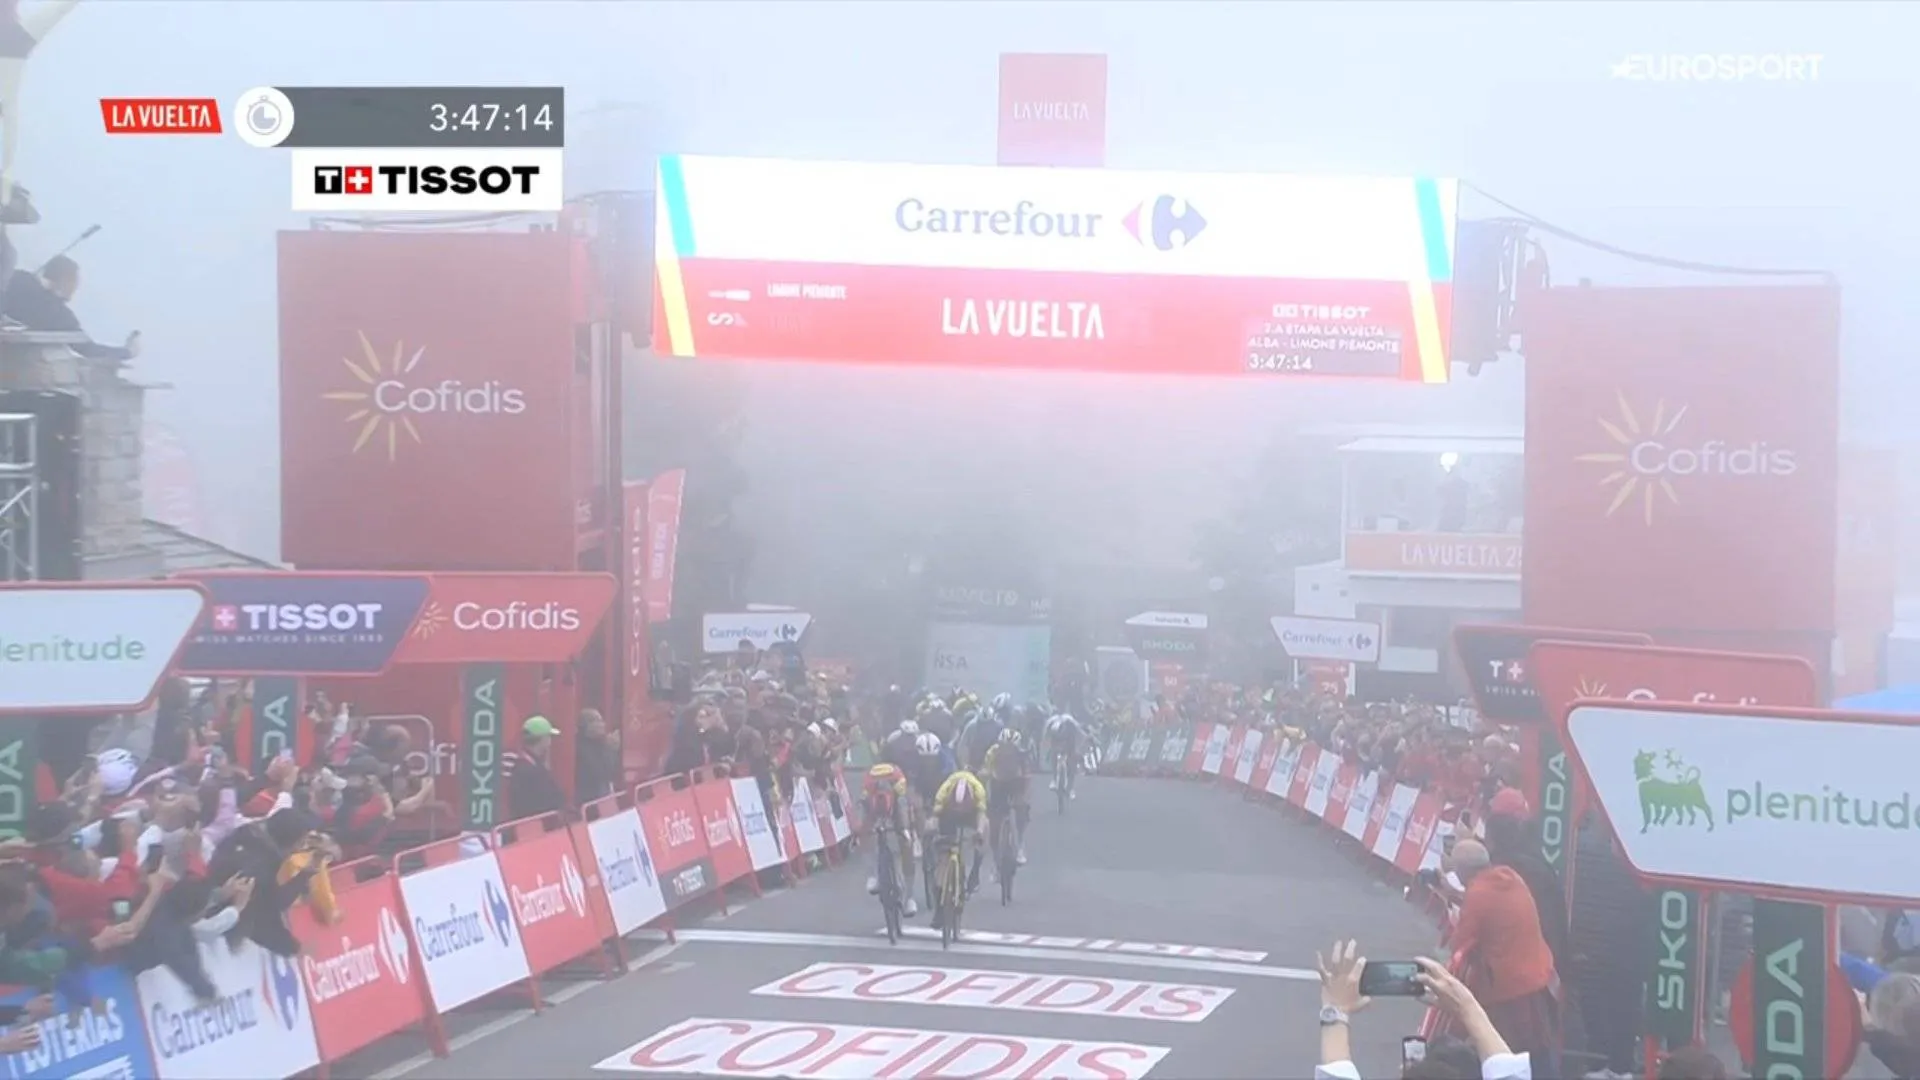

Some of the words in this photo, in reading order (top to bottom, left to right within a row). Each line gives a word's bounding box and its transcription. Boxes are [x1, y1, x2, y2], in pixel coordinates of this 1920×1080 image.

[1013, 102, 1031, 120] LA
[1033, 102, 1090, 121] VUELTA
[895, 198, 1103, 239] Carrefour
[942, 297, 980, 335] LA
[986, 300, 1105, 341] VUELTA
[1324, 324, 1339, 336] LA
[1340, 325, 1384, 338] VUELTA
[1248, 337, 1279, 349] ALBA
[1290, 338, 1336, 351] LIMONE
[1339, 339, 1399, 353] PIEMONTE
[1249, 353, 1314, 371] 3:47:14
[374, 379, 527, 415] Cofidis
[1630, 439, 1798, 476] Cofidis
[1402, 542, 1427, 566] LA
[1429, 542, 1499, 568] VUELTA
[242, 602, 382, 631] TISSOT
[453, 600, 581, 632] Cofidis
[0, 634, 146, 663] enitude
[708, 626, 769, 640] Carrefour
[1282, 630, 1343, 647] Carrefour
[511, 873, 566, 927] Carrefour
[415, 903, 485, 962] Carrefour
[303, 935, 381, 1004] Carrefour
[776, 964, 1218, 1018] COFIDIS
[628, 1019, 1150, 1080] COFIDIS
